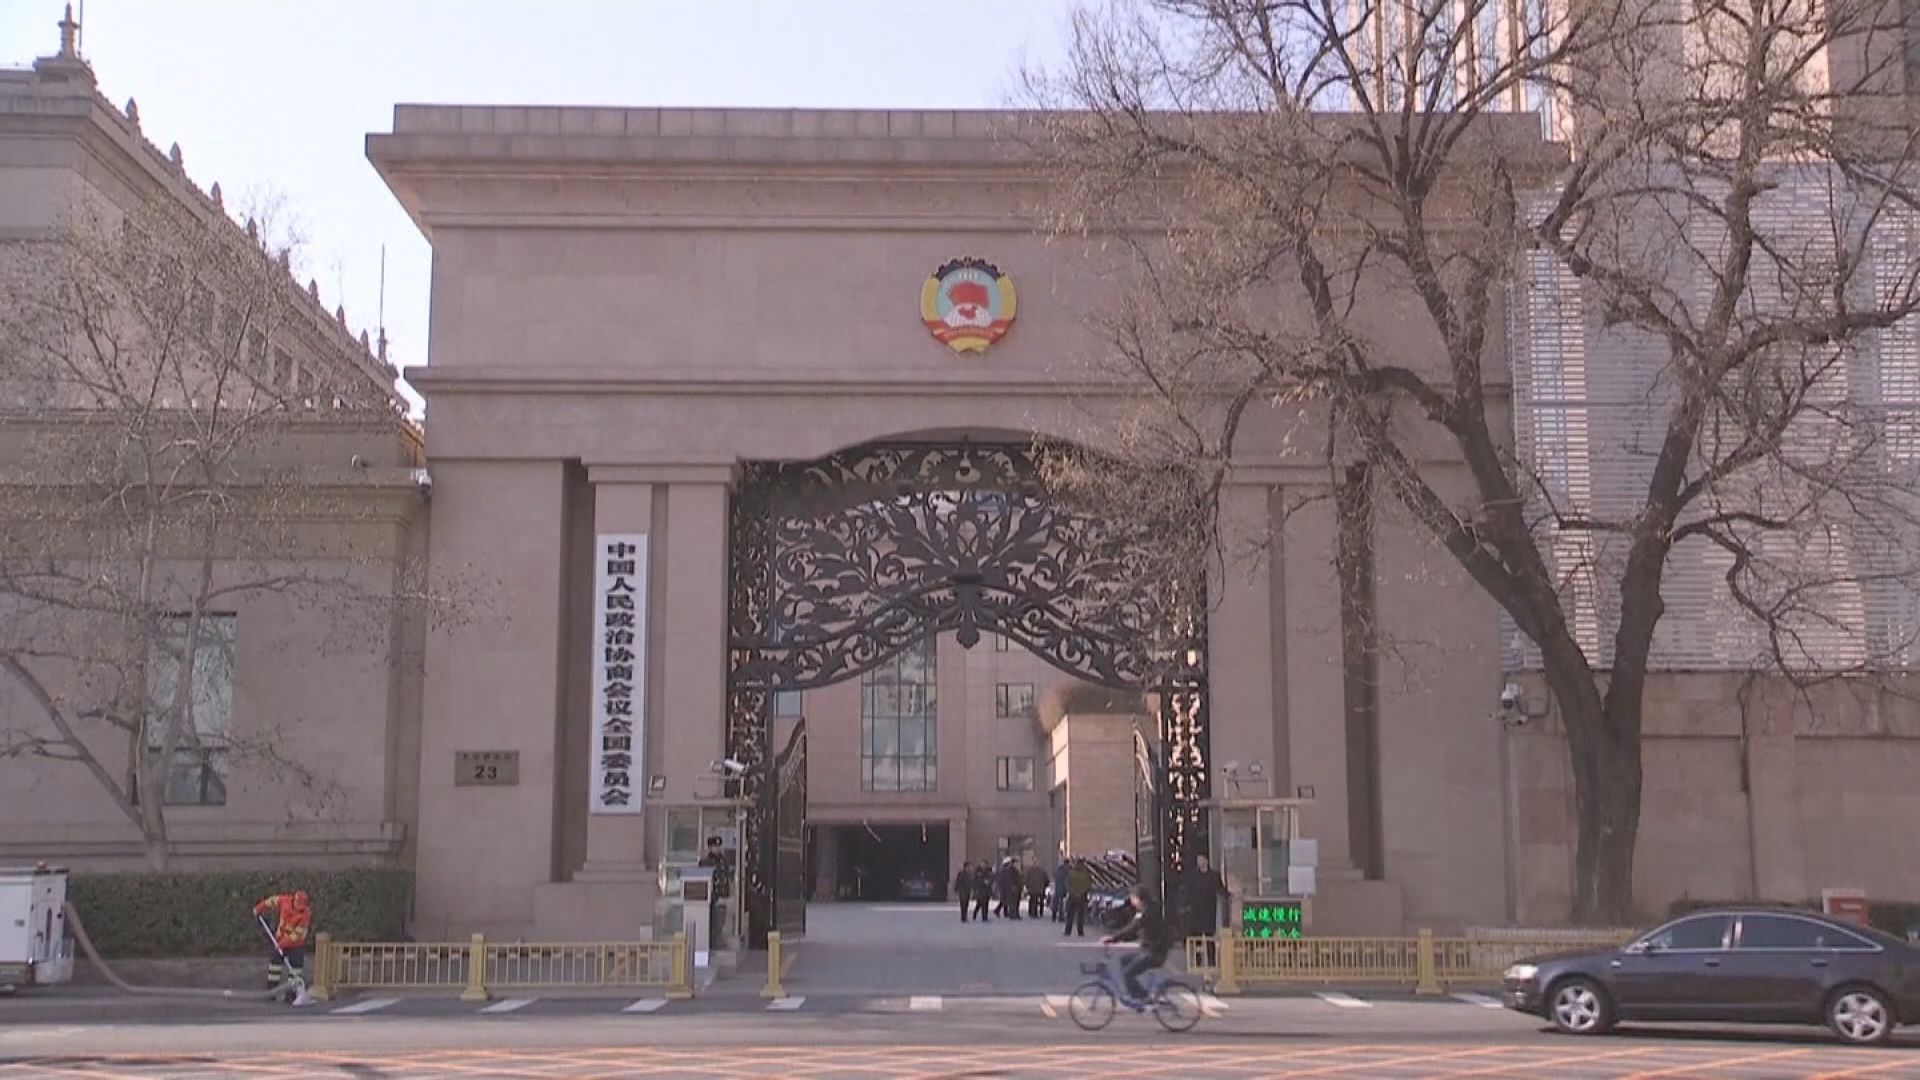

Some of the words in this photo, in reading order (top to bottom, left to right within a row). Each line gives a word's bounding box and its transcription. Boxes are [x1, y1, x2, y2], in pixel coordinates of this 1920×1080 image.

[601, 542, 636, 805] 中国人民政治协商会议全国委员会
[475, 765, 497, 780] 23
